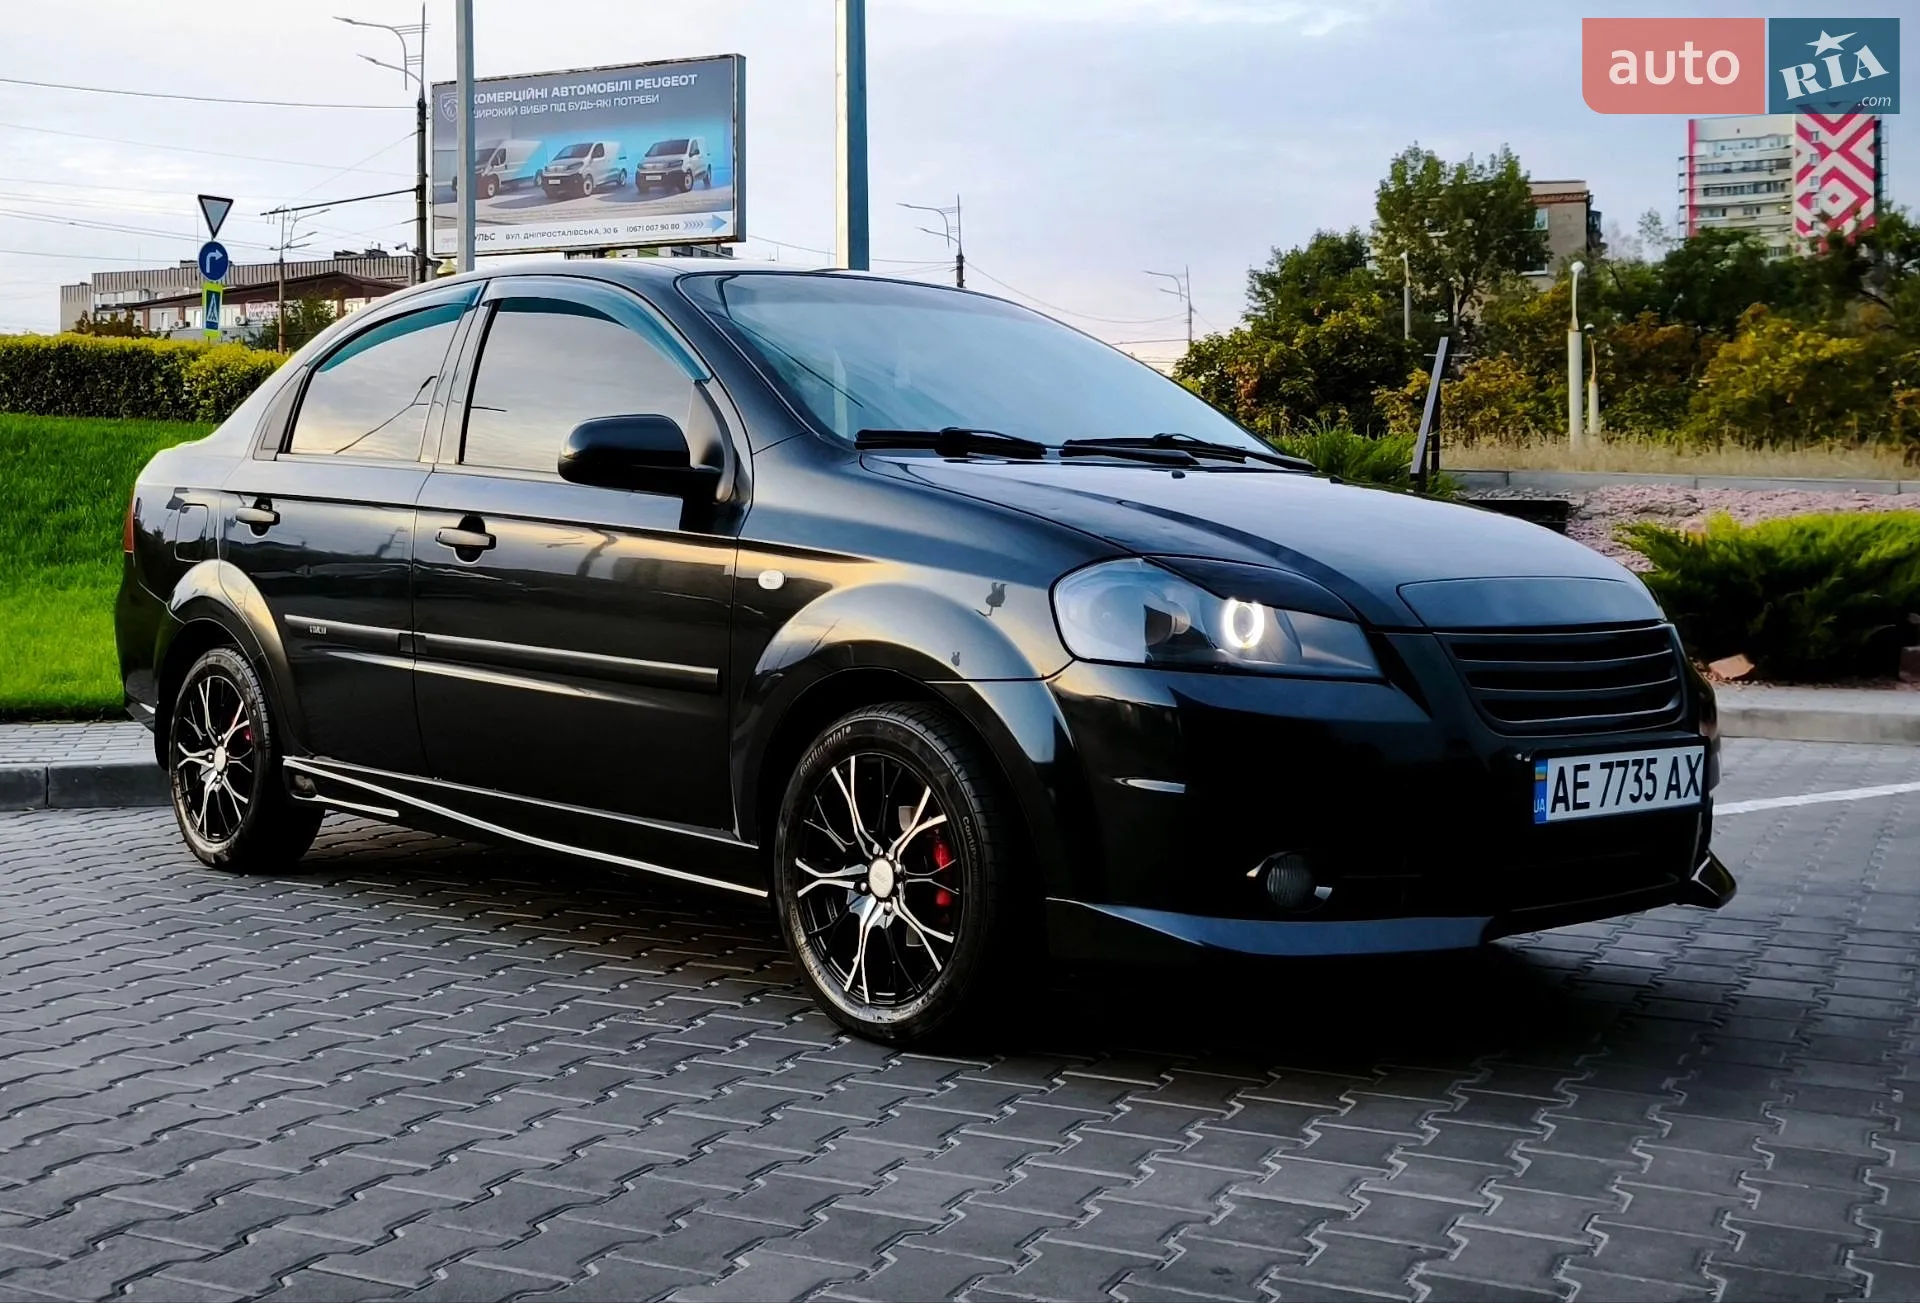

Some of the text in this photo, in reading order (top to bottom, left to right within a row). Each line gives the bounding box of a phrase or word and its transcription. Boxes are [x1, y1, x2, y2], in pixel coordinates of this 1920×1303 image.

[551, 79, 632, 98] АВТОМОБІЛІ
[635, 74, 697, 90] PEUGEOT
[520, 104, 548, 115] ВИБІР
[550, 102, 566, 113] ПІД
[568, 99, 611, 111] БУДЬ-ЯКІ
[613, 94, 660, 107] ПОТРЕБИ
[1550, 752, 1703, 813] AE 7735 AX
[1534, 798, 1545, 813] UA
